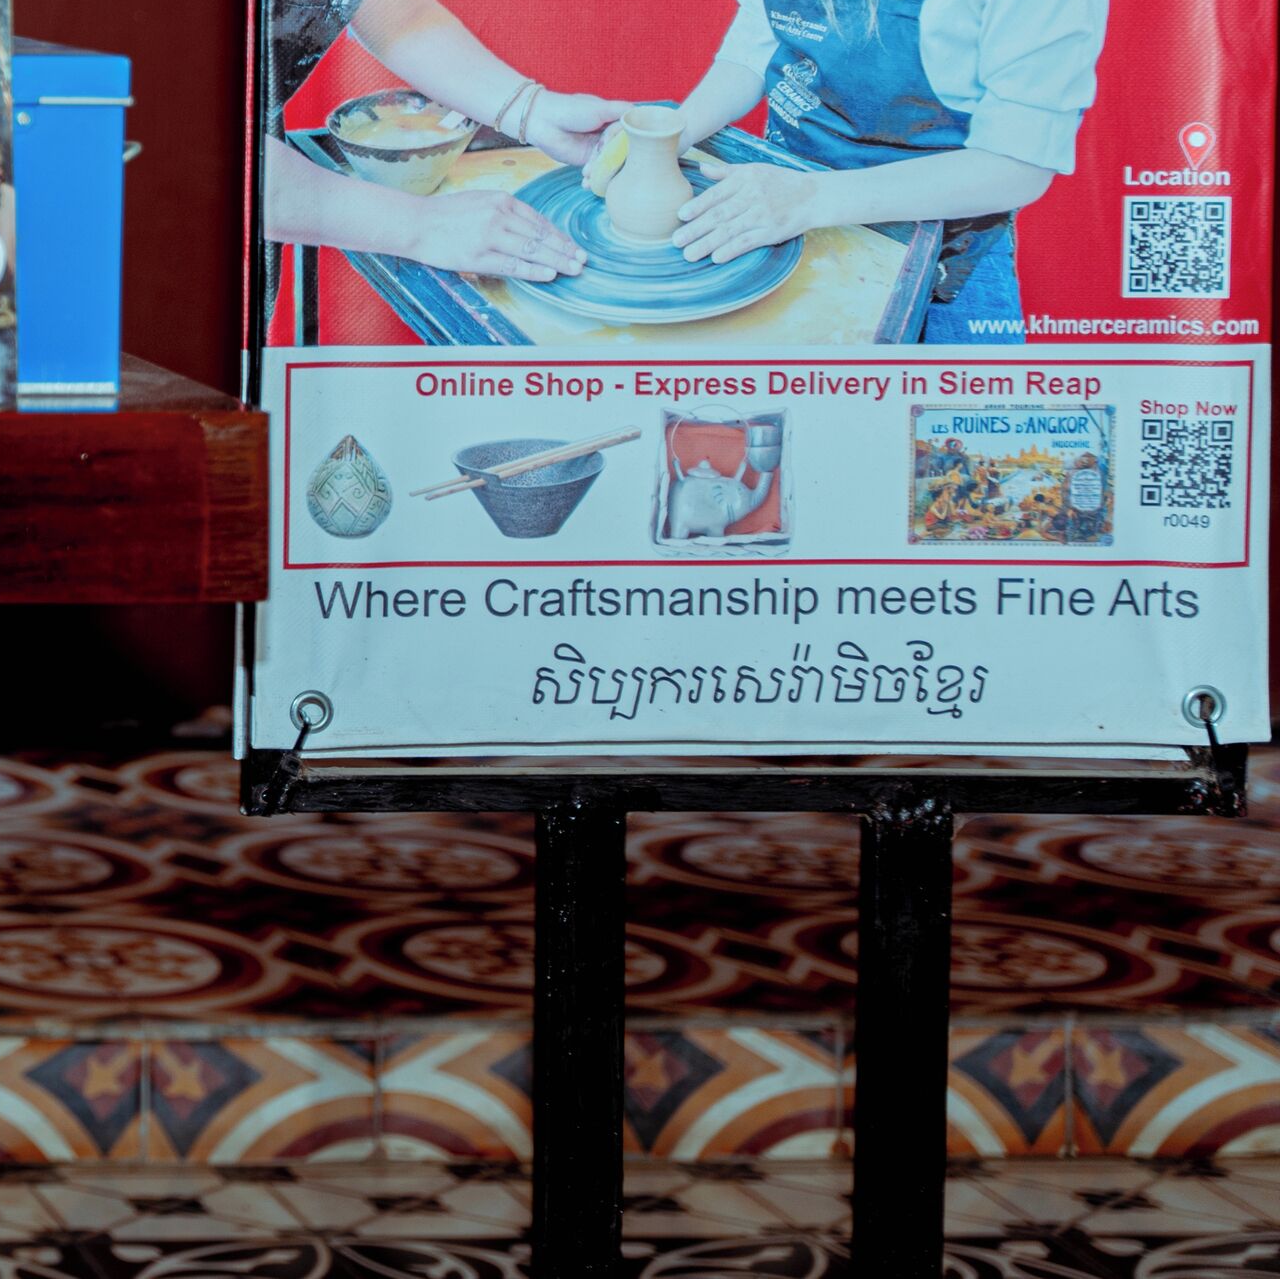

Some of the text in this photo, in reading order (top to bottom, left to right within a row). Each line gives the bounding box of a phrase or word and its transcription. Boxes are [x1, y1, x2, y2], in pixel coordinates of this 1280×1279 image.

[1124, 166, 1231, 186] Location
[967, 313, 1259, 336] www.khmerceramics.com
[415, 371, 514, 397] Online
[524, 371, 604, 402] Shop
[634, 371, 757, 402] Express
[768, 370, 891, 400] Delivery
[901, 370, 928, 396] in
[938, 370, 1014, 396] Siem
[1025, 370, 1102, 400] Reap
[1140, 400, 1238, 417] Shop Now
[1163, 513, 1211, 529] r0049
[313, 577, 1200, 624] Where Craftsmanship meets Fine Arts
